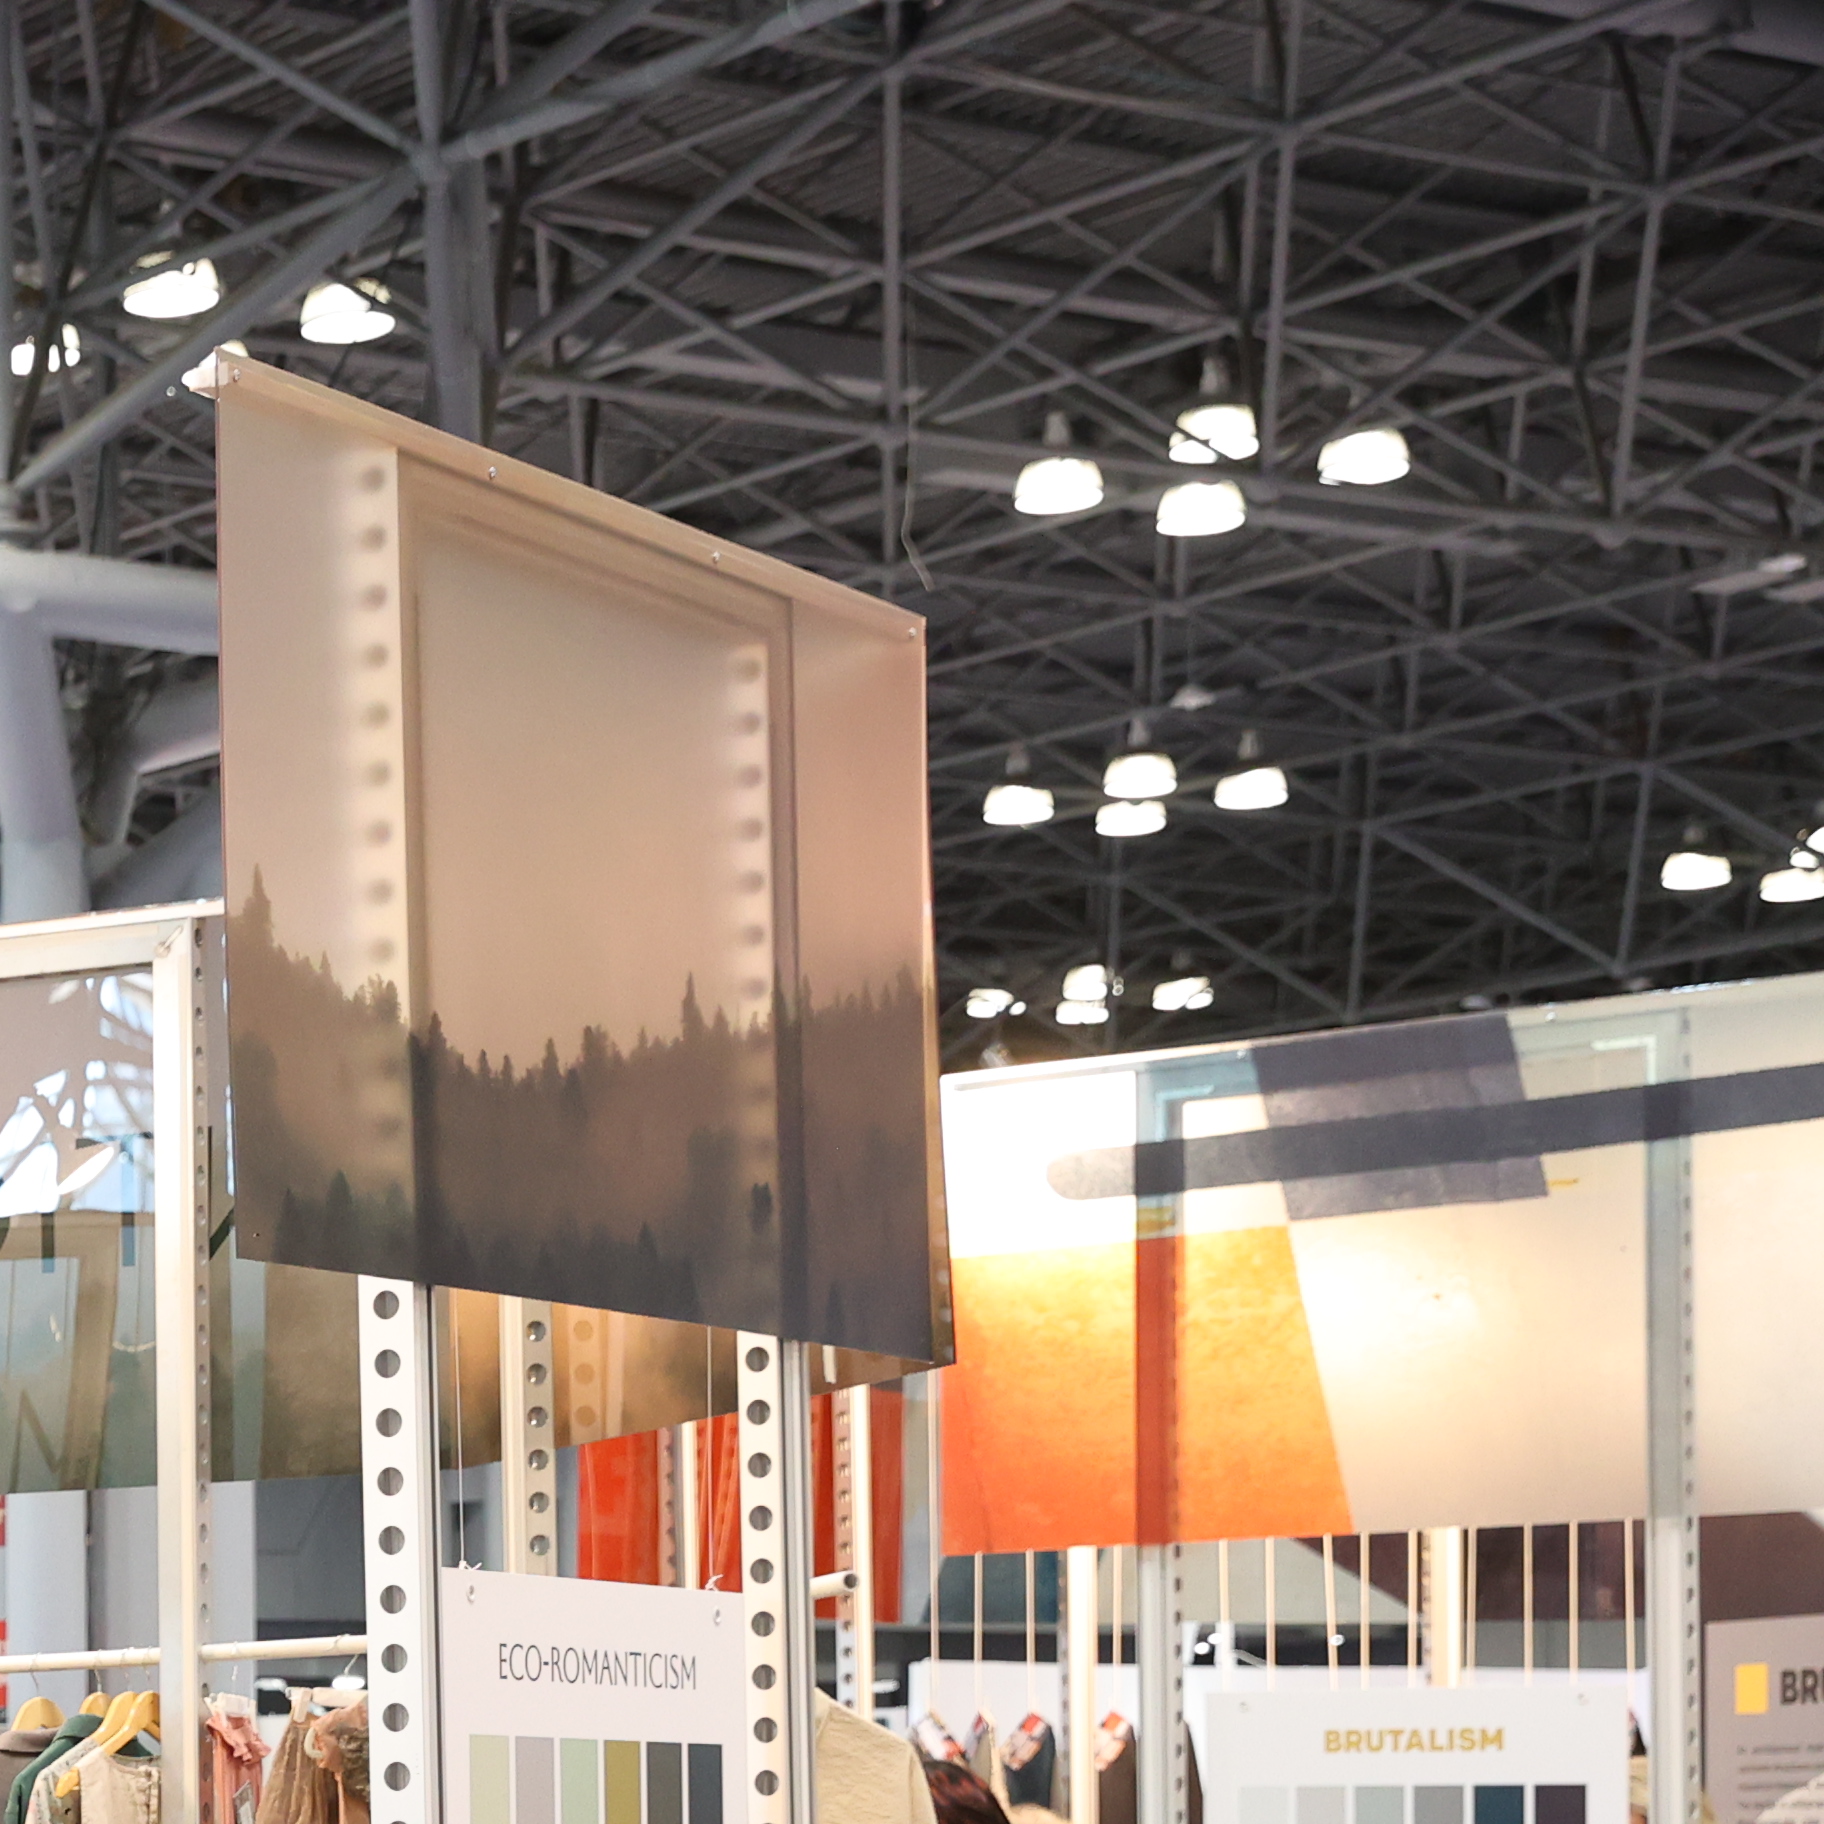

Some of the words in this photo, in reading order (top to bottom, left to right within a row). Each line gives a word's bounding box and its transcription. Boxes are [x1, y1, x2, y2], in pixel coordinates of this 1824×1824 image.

[498, 1641, 698, 1690] ECO-ROMANTICISM
[1779, 1667, 1824, 1706] BR
[1324, 1726, 1506, 1753] BRUTALISM
